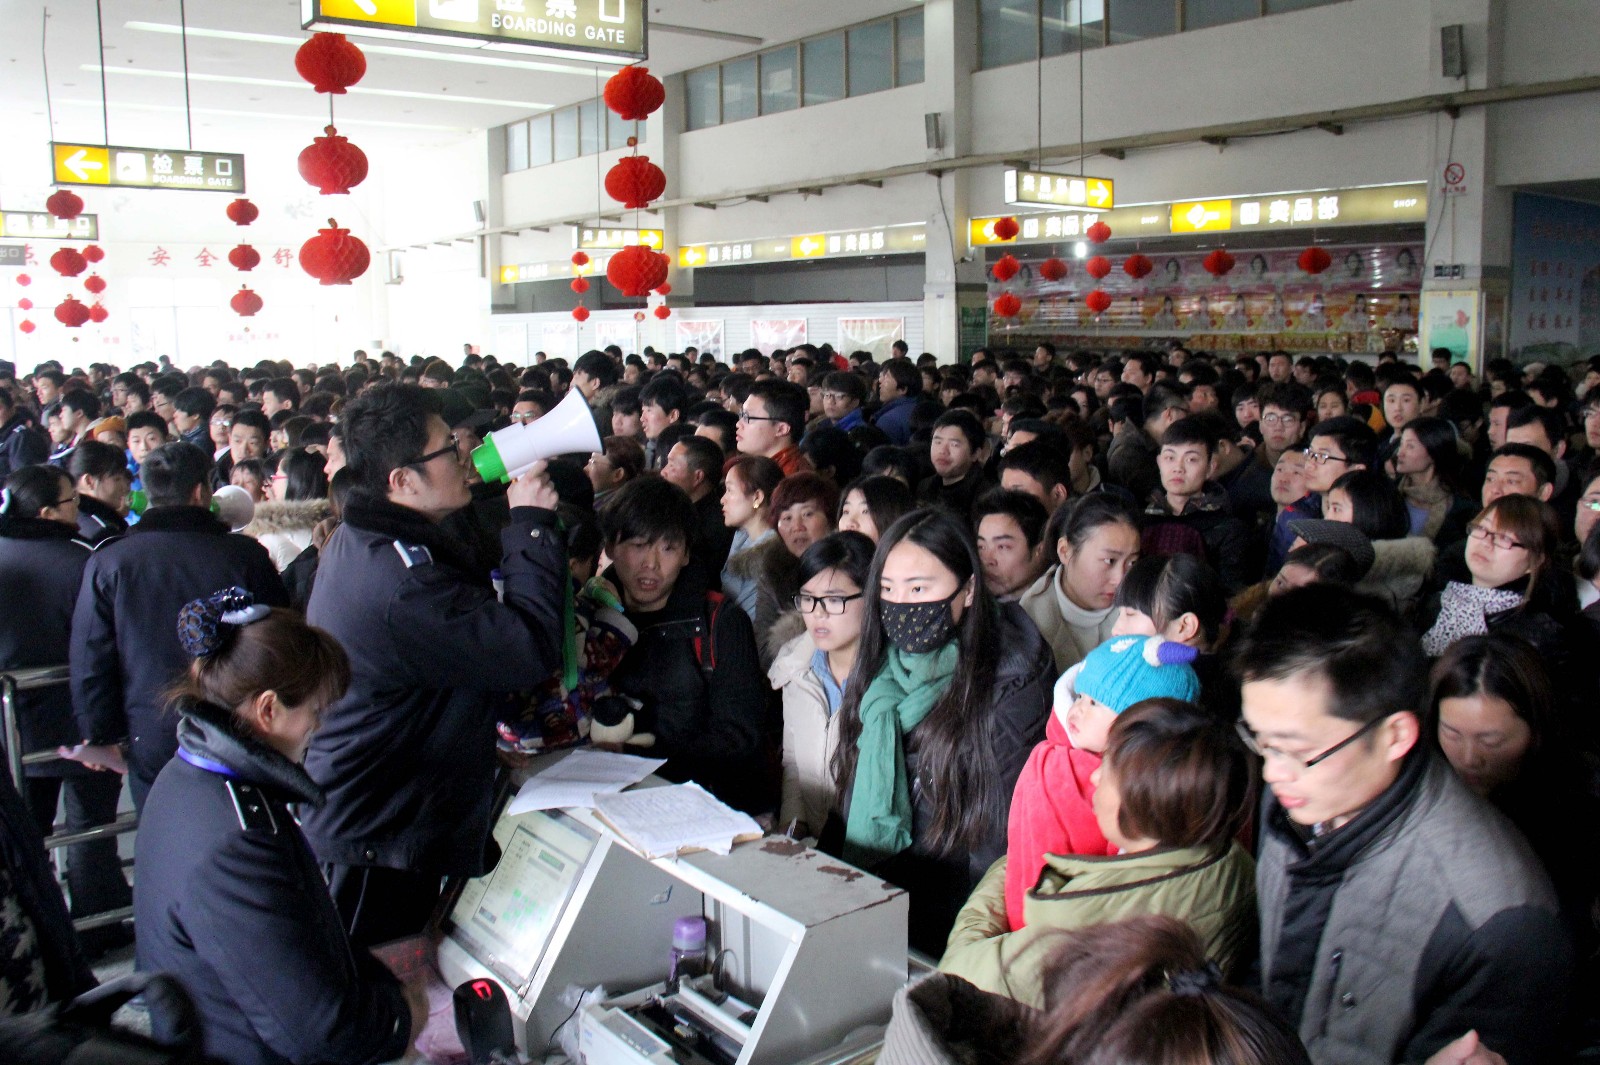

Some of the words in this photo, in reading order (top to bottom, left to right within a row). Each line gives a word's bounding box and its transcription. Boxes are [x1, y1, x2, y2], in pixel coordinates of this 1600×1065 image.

[491, 13, 576, 37] BOARDING
[584, 25, 625, 43] GATE
[152, 153, 233, 176] 检票口
[207, 177, 233, 187] GATE
[1393, 199, 1417, 209] SHOP
[147, 245, 219, 267] 安全
